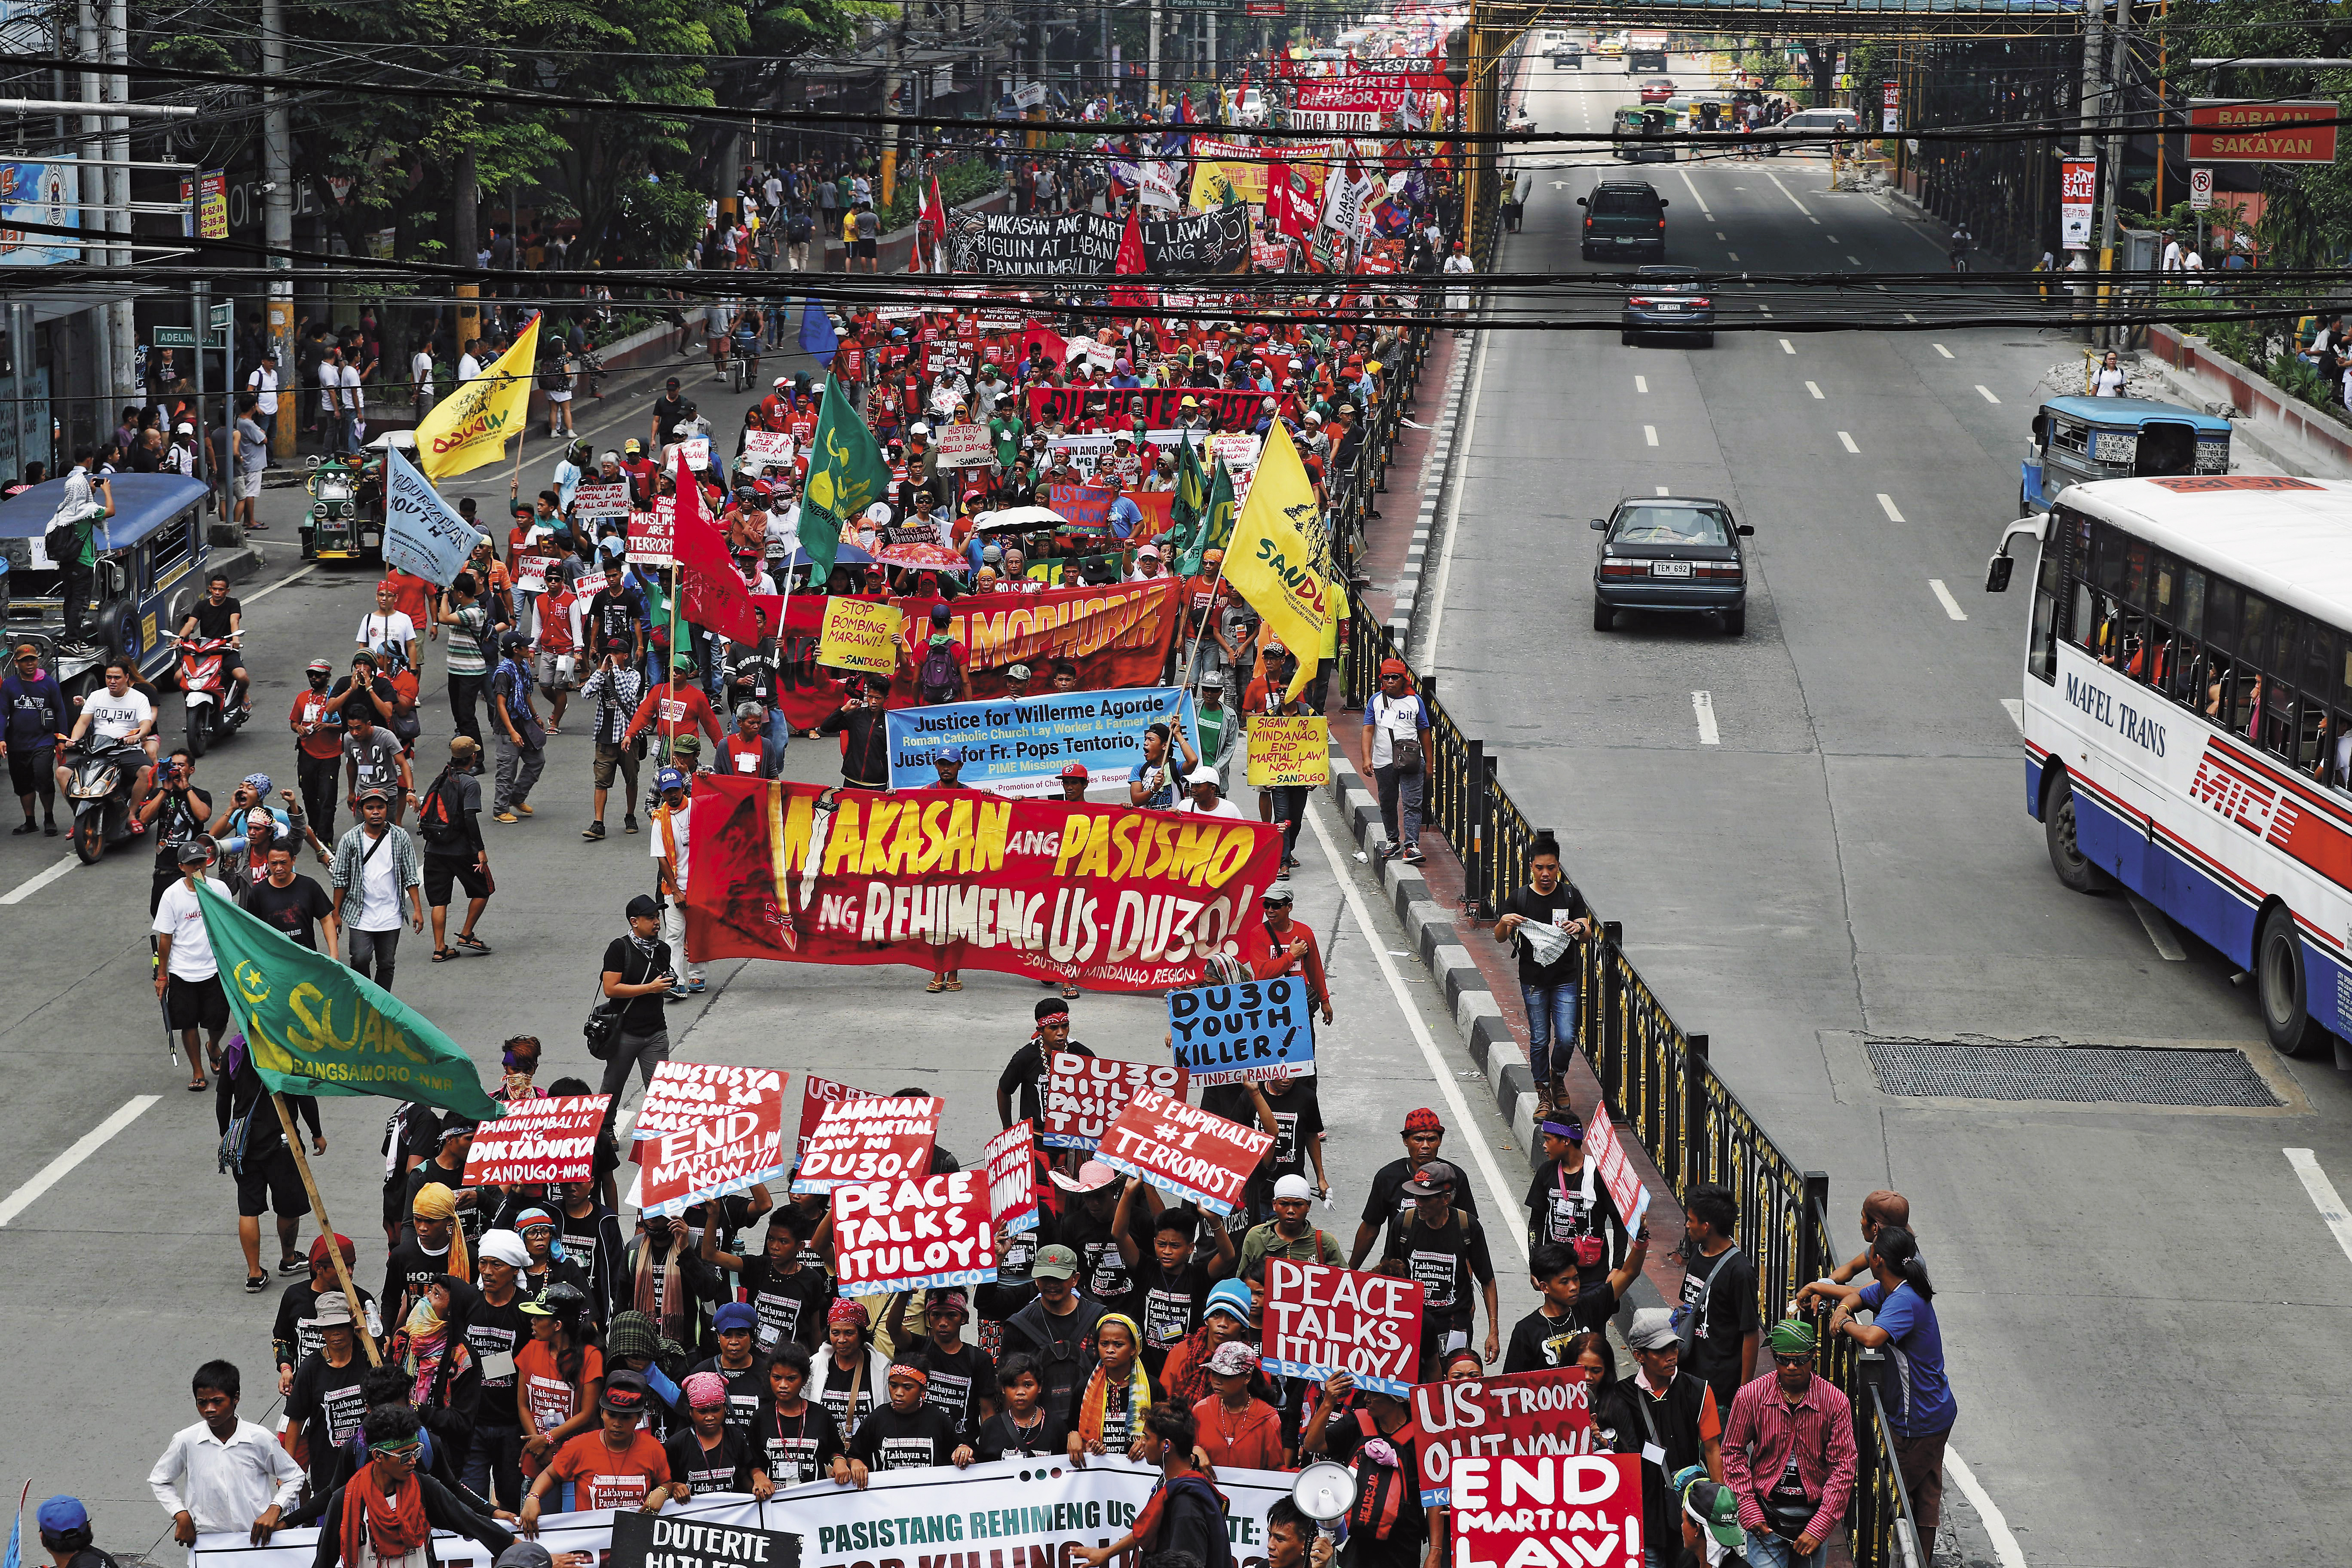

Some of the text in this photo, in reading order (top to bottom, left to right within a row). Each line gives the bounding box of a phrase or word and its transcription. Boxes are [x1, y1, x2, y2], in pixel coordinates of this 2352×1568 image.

[1371, 59, 1432, 72] RESIST
[1319, 77, 1400, 95] DUTERTE
[2219, 112, 2309, 126] BABAAN
[2212, 138, 2312, 154] SAKAYAN
[2063, 173, 2094, 184] 3-DAY
[2063, 184, 2092, 197] SALE
[988, 214, 1209, 245] WAKASAN ANG MARTAL LAW!
[977, 234, 1195, 261] BIGUIN AT ANG
[942, 347, 958, 355] END
[959, 342, 973, 351] WAR!
[755, 432, 780, 441] DUTERTE
[948, 424, 982, 435] HUSTISYA
[943, 434, 977, 444] para kay
[1213, 437, 1256, 447] IPAGTANGGOL
[1227, 445, 1250, 453] LUPANG
[758, 458, 788, 466] -SANDUGO
[955, 456, 992, 466] -SANDUGO
[575, 484, 623, 493] LABANAN ang
[1050, 485, 1111, 504] US TROOPS
[612, 498, 631, 508] WAR!
[657, 497, 677, 507] STOP
[390, 495, 442, 538] YOUTH
[646, 525, 665, 536] ARE
[895, 527, 917, 536] JUSTICE
[898, 533, 934, 542] NURMAYDA
[1657, 564, 1687, 573] TEM 692
[1011, 582, 1044, 593] IS NOT
[840, 601, 875, 617] STOP
[1299, 603, 1321, 623] KATUTUBONG
[830, 615, 888, 634] BOMBING
[827, 629, 887, 647] MARAWI!
[839, 653, 891, 669] -SANDUGO
[914, 695, 1164, 733] Justice for Willerme Agorde
[2065, 672, 2165, 758] MAFEL TRANS
[903, 717, 1145, 747] Roman Catholic Church Lay Worker & Farmer
[1257, 718, 1308, 731] SIGAW ng
[1250, 730, 1320, 743] MINDANAO,
[961, 744, 986, 763] for
[990, 743, 1011, 761] Fr.
[1016, 738, 1060, 761] Pops
[1063, 732, 1140, 753] Tentorio,
[1270, 742, 1297, 753] END
[989, 757, 1080, 775] PIME Missionary
[1249, 753, 1292, 764] MARTIAL
[1268, 760, 1302, 773] NOW!
[660, 772, 678, 782] PBA
[1270, 773, 1325, 783] -SANDUGO
[995, 781, 1044, 793] -Promotion of
[783, 795, 1255, 889] WAKASAN ANG PASISMO
[818, 882, 1255, 964] NG REHIMENG US-DU30!
[1017, 953, 1197, 986] -SOUTHERN MINDANAO REGION
[1172, 980, 1291, 1018] DU30
[1172, 1006, 1291, 1040] YOUTH
[1175, 1029, 1296, 1069] KILLER!
[294, 1057, 453, 1092] BANGSAMORO -NMR
[653, 1061, 781, 1092] HUSTISYA
[1053, 1052, 1180, 1085] DU30
[645, 1081, 763, 1106] PARA SA
[560, 1096, 611, 1113] ANG
[819, 1097, 934, 1122] LABANAN
[476, 1114, 594, 1135] PANUNUMBALIK
[1133, 1089, 1275, 1155] US EMPIRIALIST
[662, 1112, 760, 1165] END
[466, 1135, 596, 1164] DIKTADURYA
[652, 1129, 782, 1187] MARTIAL LAW
[801, 1146, 924, 1180] DU30!
[1116, 1125, 1246, 1198] TERRORIST
[481, 1164, 590, 1182] SANDUGO-NMR
[835, 1171, 974, 1221] PEACE
[836, 1206, 967, 1250] TALKS
[838, 1222, 993, 1280] ITULOY!
[1414, 1270, 1452, 1282] Pambansang
[1415, 1262, 1444, 1272] Lakbayan
[1272, 1259, 1415, 1320] PEACE
[1268, 1300, 1402, 1349] TALKS
[1276, 1336, 1413, 1382] ITULOY!
[331, 1398, 363, 1411] Lakbayan
[1417, 1381, 1588, 1433] US TROOPS
[334, 1418, 361, 1427] Minorya
[335, 1429, 355, 1439] 2017
[1451, 1456, 1620, 1510] END
[819, 1501, 1101, 1554] PASISTANG REHIMENG
[1457, 1509, 1619, 1533] MARTIAL
[652, 1519, 771, 1563] DUTERTE
[1454, 1515, 1640, 1568] LAW!
